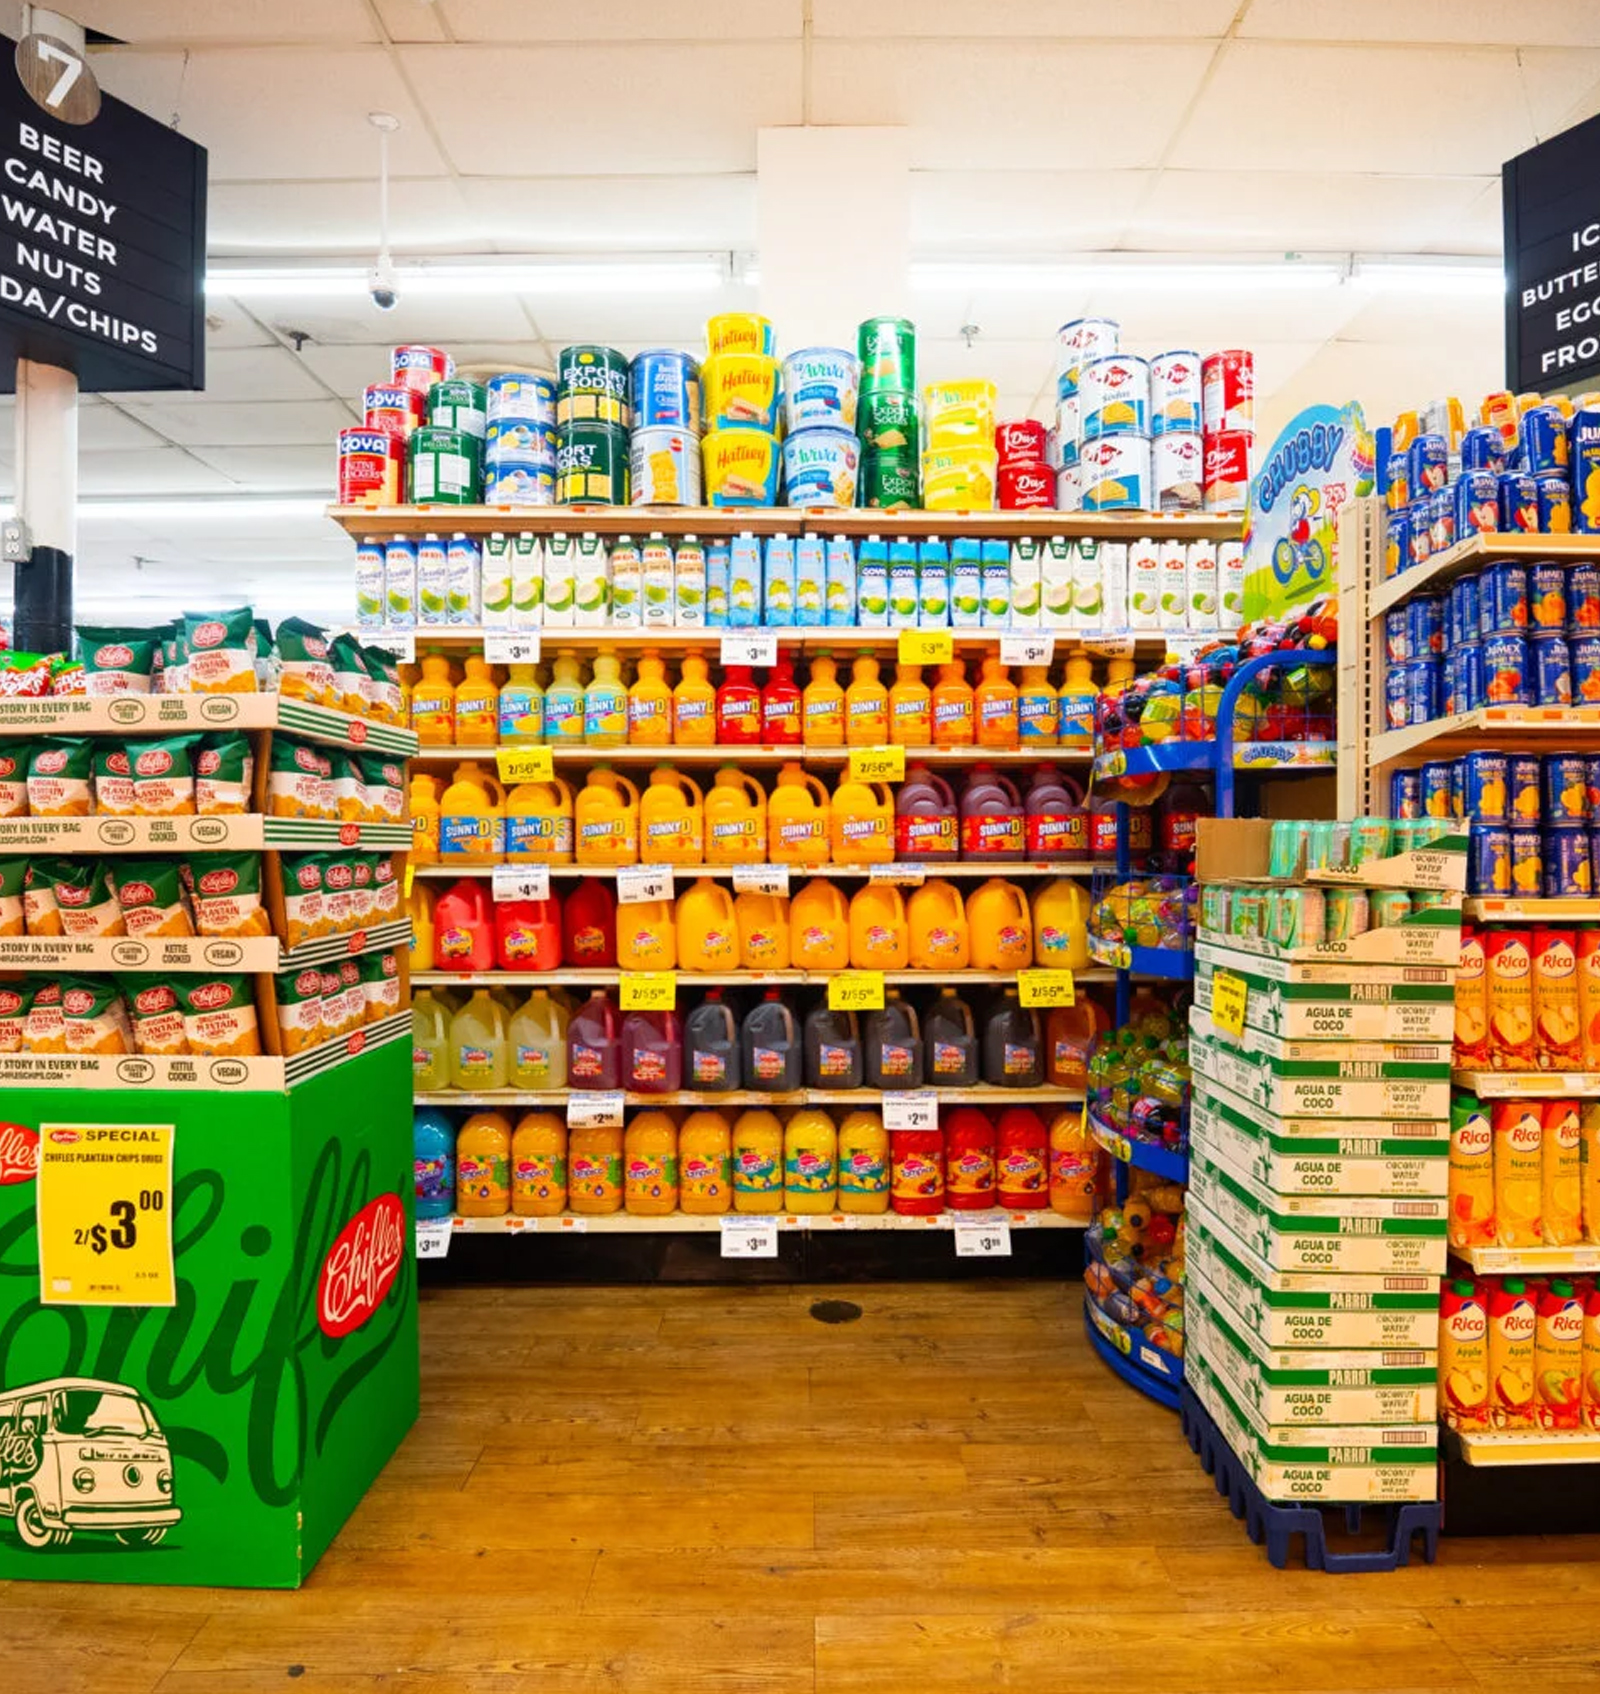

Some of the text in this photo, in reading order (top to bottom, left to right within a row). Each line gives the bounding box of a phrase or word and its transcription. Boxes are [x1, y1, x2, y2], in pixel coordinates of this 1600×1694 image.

[38, 40, 82, 108] 7
[20, 122, 104, 184] BEER
[4, 158, 117, 225] CANDY
[1, 195, 117, 265] WATER
[17, 243, 101, 295] NUTS
[1522, 261, 1600, 308] BUTTE
[563, 366, 626, 386] EXPORT
[722, 370, 771, 391] Hatuey
[568, 375, 624, 398] SODAS
[366, 389, 407, 407] GOYA
[1009, 430, 1037, 445] Dux
[341, 437, 386, 454] GOYA
[717, 444, 766, 468] Hatuey
[1258, 423, 1344, 514] CHUBBY
[1018, 475, 1046, 491] Dux
[42, 702, 70, 713] EVERY
[73, 702, 91, 712] BAG
[161, 700, 183, 709] KETTLE
[206, 703, 233, 716] VEGAN
[158, 711, 187, 720] COOKED
[1242, 746, 1295, 763] CHUBBY
[32, 823, 60, 833] EVERY
[62, 822, 81, 833] BAG
[150, 822, 173, 831] KETTLE
[197, 826, 222, 836] VEGAN
[148, 832, 177, 842] COOKED
[201, 870, 238, 892] Chifles
[44, 943, 73, 952] EVERY
[75, 943, 94, 953] BAG
[165, 944, 188, 953] KETTLE
[211, 950, 236, 959] VEGAN
[162, 954, 191, 963] COOKED
[1497, 954, 1528, 968] Rica
[1542, 954, 1572, 968] Rica
[189, 985, 232, 1009] Chifles
[1350, 984, 1392, 1000] PARROT
[1306, 1008, 1353, 1018] AGUA DE
[1313, 1020, 1344, 1031] COCO
[4, 1060, 99, 1070] STORY IN EVERY BAG
[170, 1061, 193, 1071] KETTLE
[1340, 1062, 1382, 1078] PARROT
[168, 1071, 197, 1082] COOKED
[217, 1067, 241, 1077] VEGAN
[1294, 1085, 1342, 1095] AGUA DE
[1303, 1098, 1333, 1108] COCO
[85, 1130, 161, 1142] SPECIAL
[1460, 1129, 1490, 1146] Rica
[1512, 1128, 1540, 1143] Rica
[1339, 1139, 1382, 1155] PARROT
[45, 1153, 75, 1163] CHIFLES
[77, 1153, 114, 1163] PLANTAIN
[115, 1153, 139, 1164] CHIPS
[1294, 1162, 1341, 1173] AGUA DE
[1302, 1175, 1333, 1186] COCO
[1339, 1217, 1383, 1234] PARROT
[1293, 1240, 1341, 1251] AGUA DE
[324, 1206, 403, 1322] Chifles
[1301, 1253, 1333, 1263] COCO
[1330, 1293, 1373, 1309] PARROT
[1284, 1316, 1332, 1326] AGUA DE
[1452, 1317, 1484, 1331] Rica
[1504, 1316, 1534, 1330] Rica
[1292, 1329, 1323, 1339] COCO
[1456, 1347, 1482, 1357] Apple
[1328, 1370, 1372, 1385] PARROT
[1284, 1393, 1331, 1404] AGUA DE
[1292, 1406, 1323, 1416] COCO
[1328, 1447, 1372, 1463] PARROT
[1291, 1482, 1323, 1493] COCO
